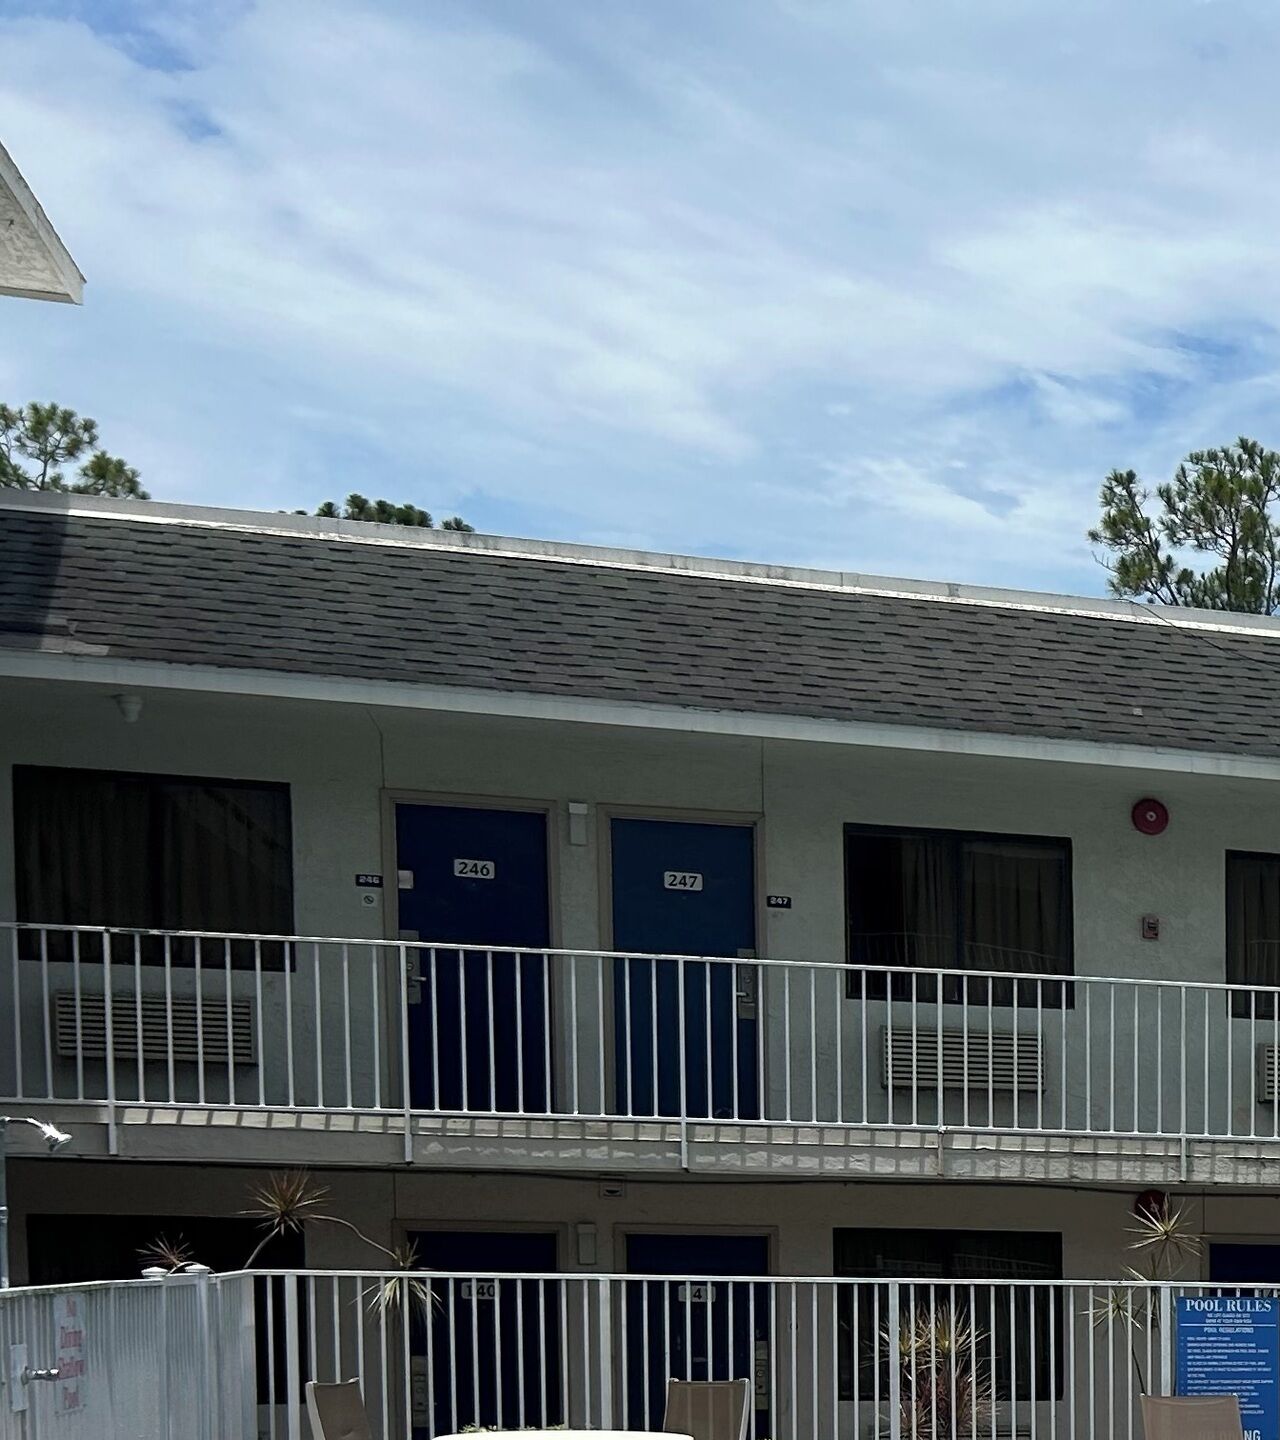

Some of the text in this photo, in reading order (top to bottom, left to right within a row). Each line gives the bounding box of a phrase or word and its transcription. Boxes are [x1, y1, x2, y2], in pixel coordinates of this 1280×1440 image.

[458, 861, 490, 877] 246
[668, 873, 698, 889] 247
[1185, 1299, 1272, 1312] POOL RULES
